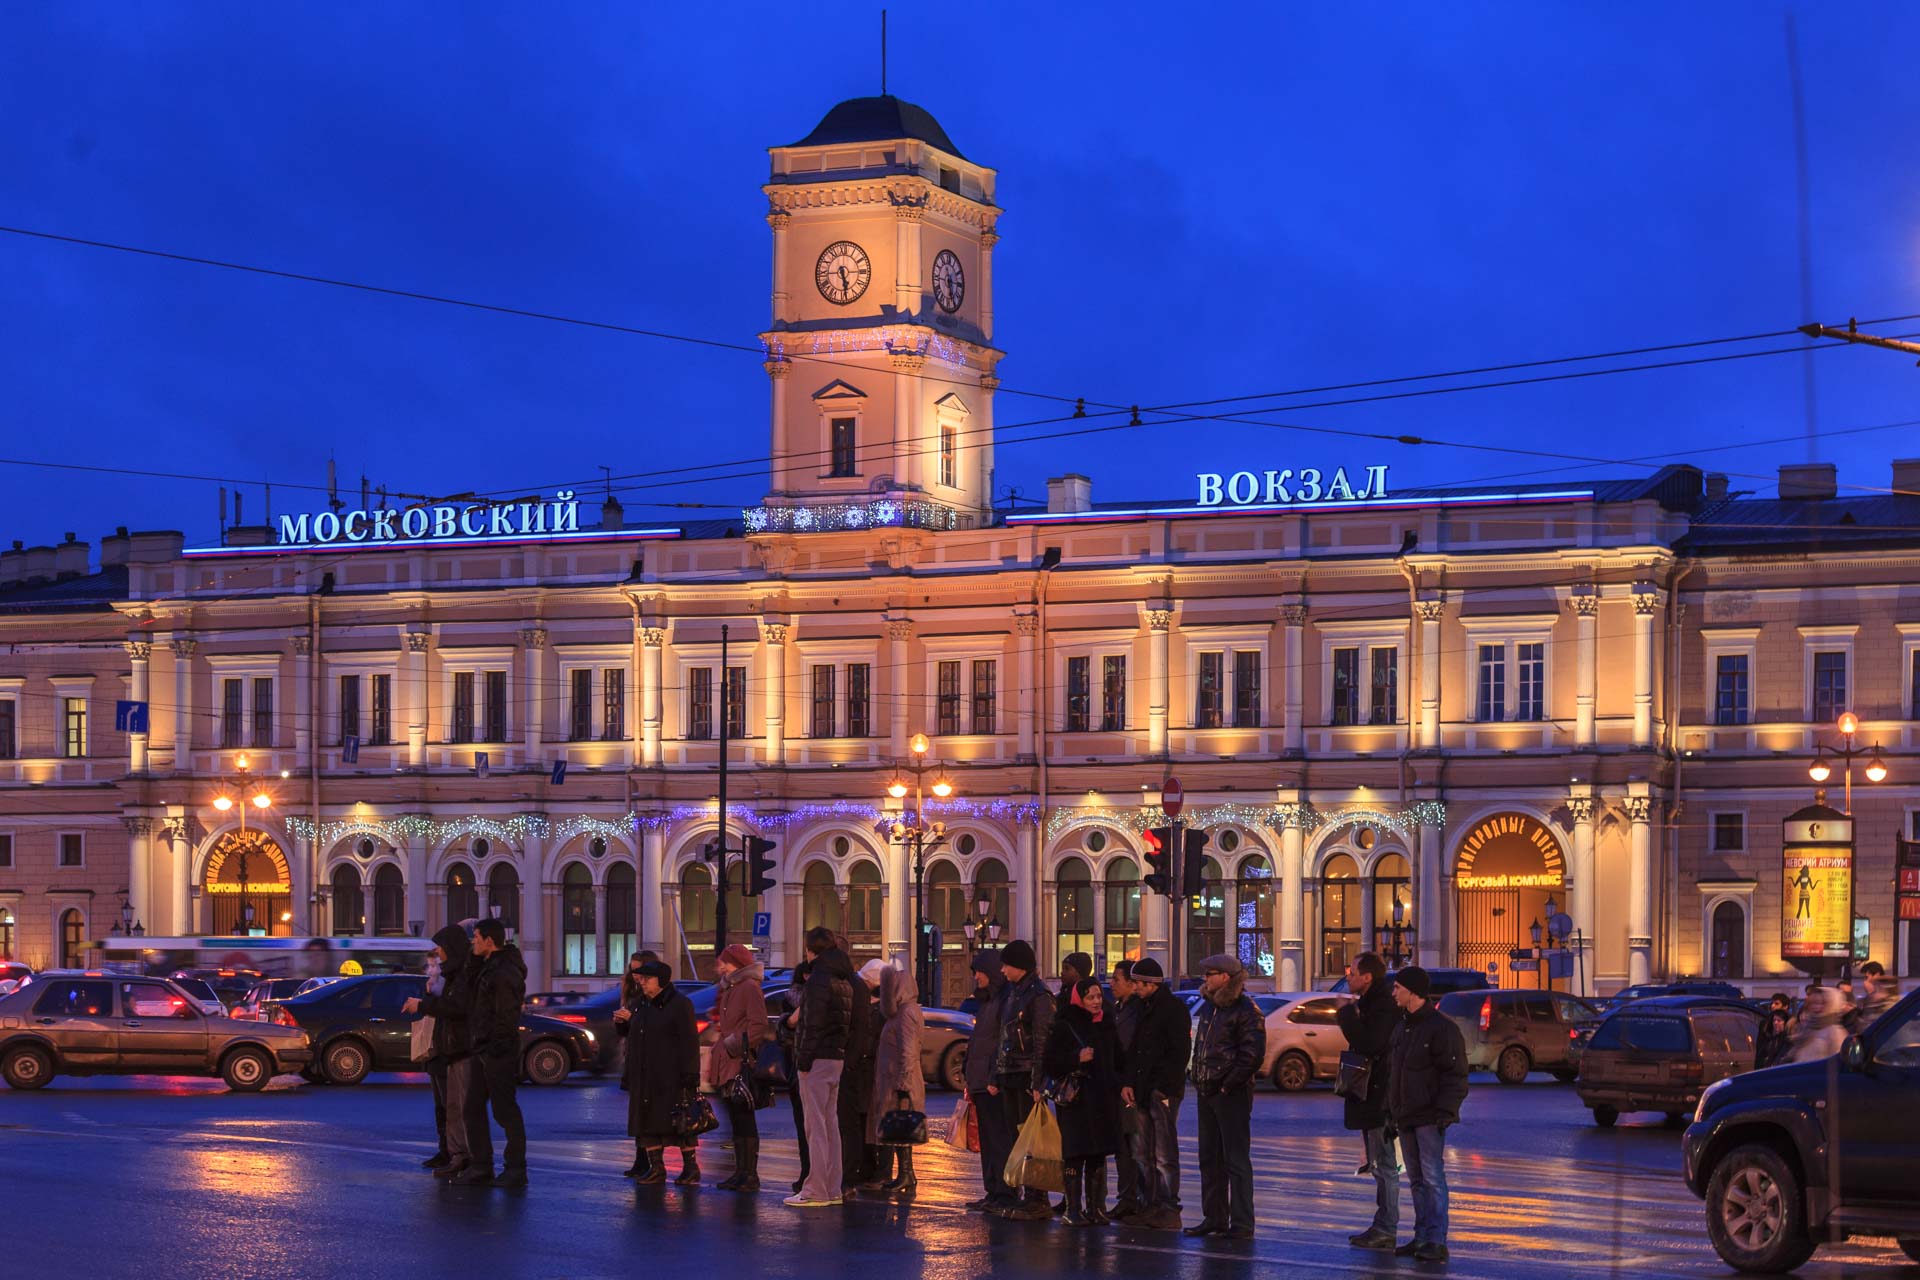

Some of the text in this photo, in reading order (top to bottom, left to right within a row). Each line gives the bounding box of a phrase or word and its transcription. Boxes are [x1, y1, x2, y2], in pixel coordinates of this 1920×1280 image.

[1196, 465, 1389, 506] ВОКЗАЛ
[279, 490, 580, 545] МОСКОВСКИЙ
[1457, 816, 1526, 878] ПРИГОРОДНЫЕ
[1818, 857, 1848, 868] АТРИУМ
[1457, 874, 1562, 888] ТОРГОВЫЙ КОМПЛЕКС
